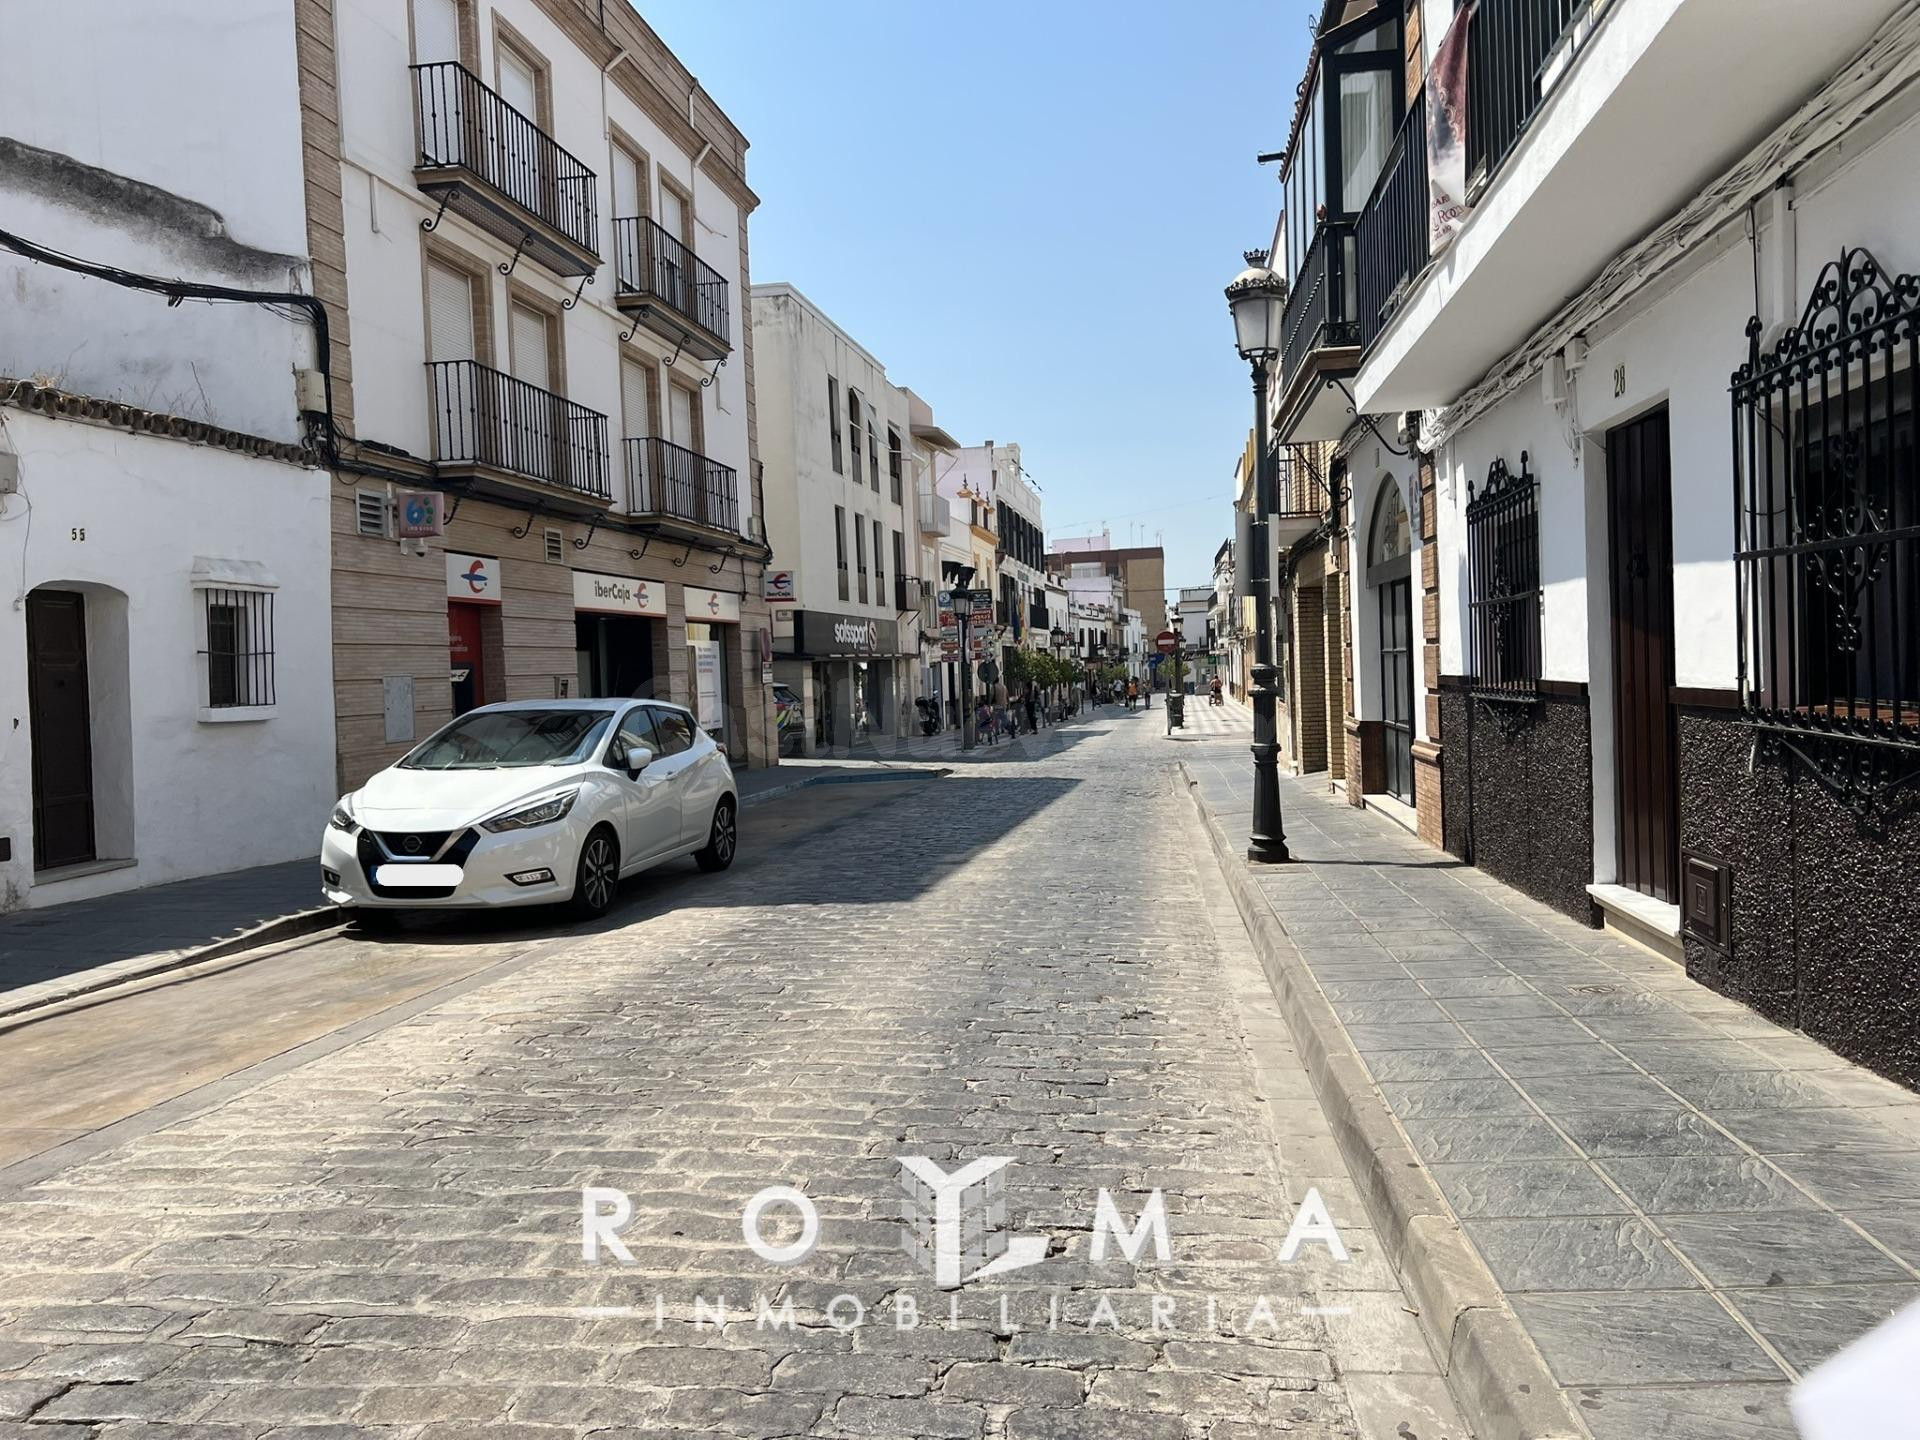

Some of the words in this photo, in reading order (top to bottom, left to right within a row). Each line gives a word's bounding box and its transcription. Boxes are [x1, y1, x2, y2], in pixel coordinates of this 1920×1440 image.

[1613, 365, 1626, 398] 28
[71, 527, 85, 541] 55
[594, 580, 631, 604] iberCaja
